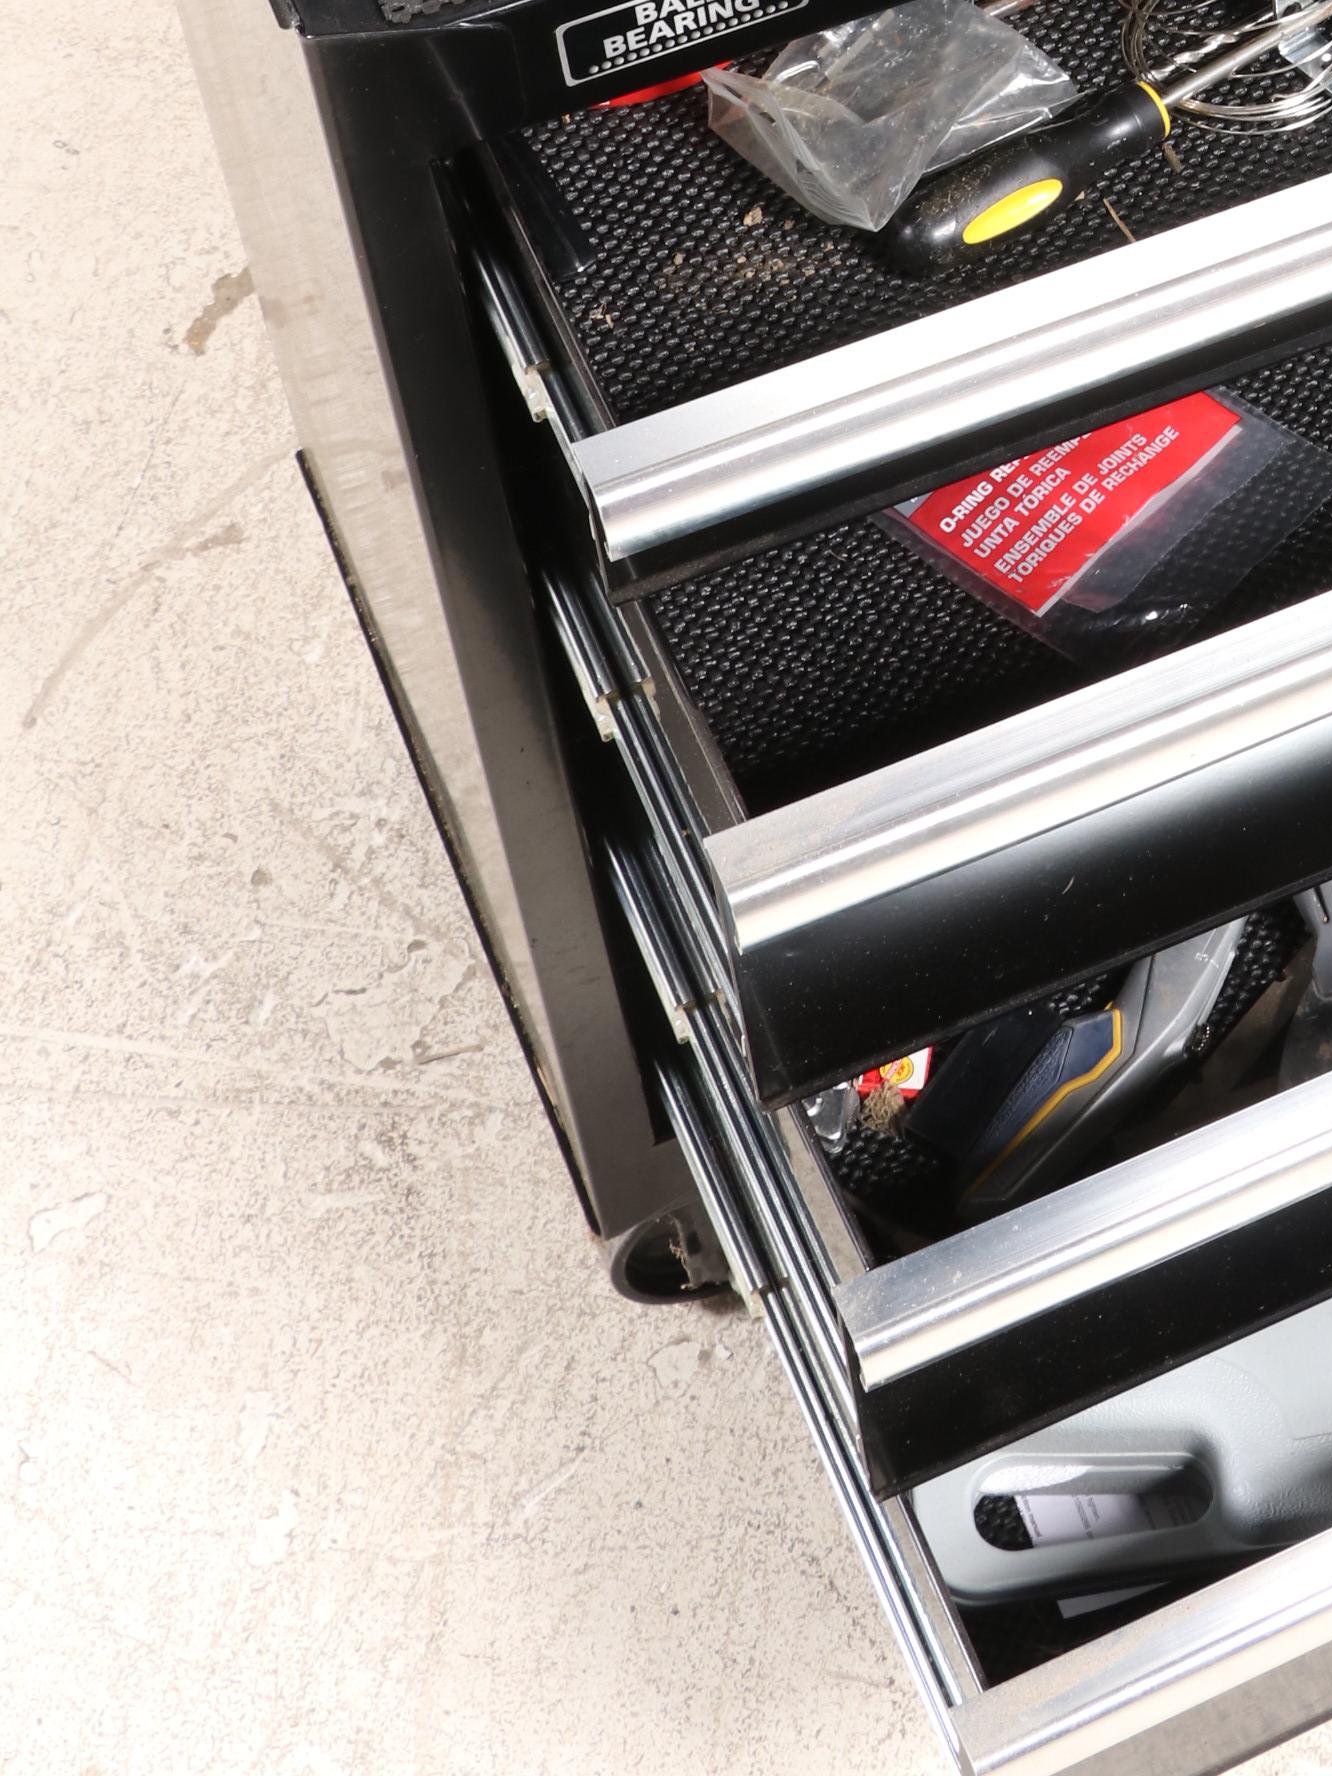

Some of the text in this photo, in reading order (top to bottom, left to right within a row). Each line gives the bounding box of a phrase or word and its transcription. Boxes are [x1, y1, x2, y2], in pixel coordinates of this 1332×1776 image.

[939, 454, 1030, 534] O-RING RE
[960, 432, 1092, 549] JUEGO DE REEMP
[972, 465, 1072, 560] UNTA TÓRICA
[993, 432, 1149, 577] ENSEMBLE DE JOINTS
[1007, 425, 1181, 585] TORIQUES DE RECHANGE
